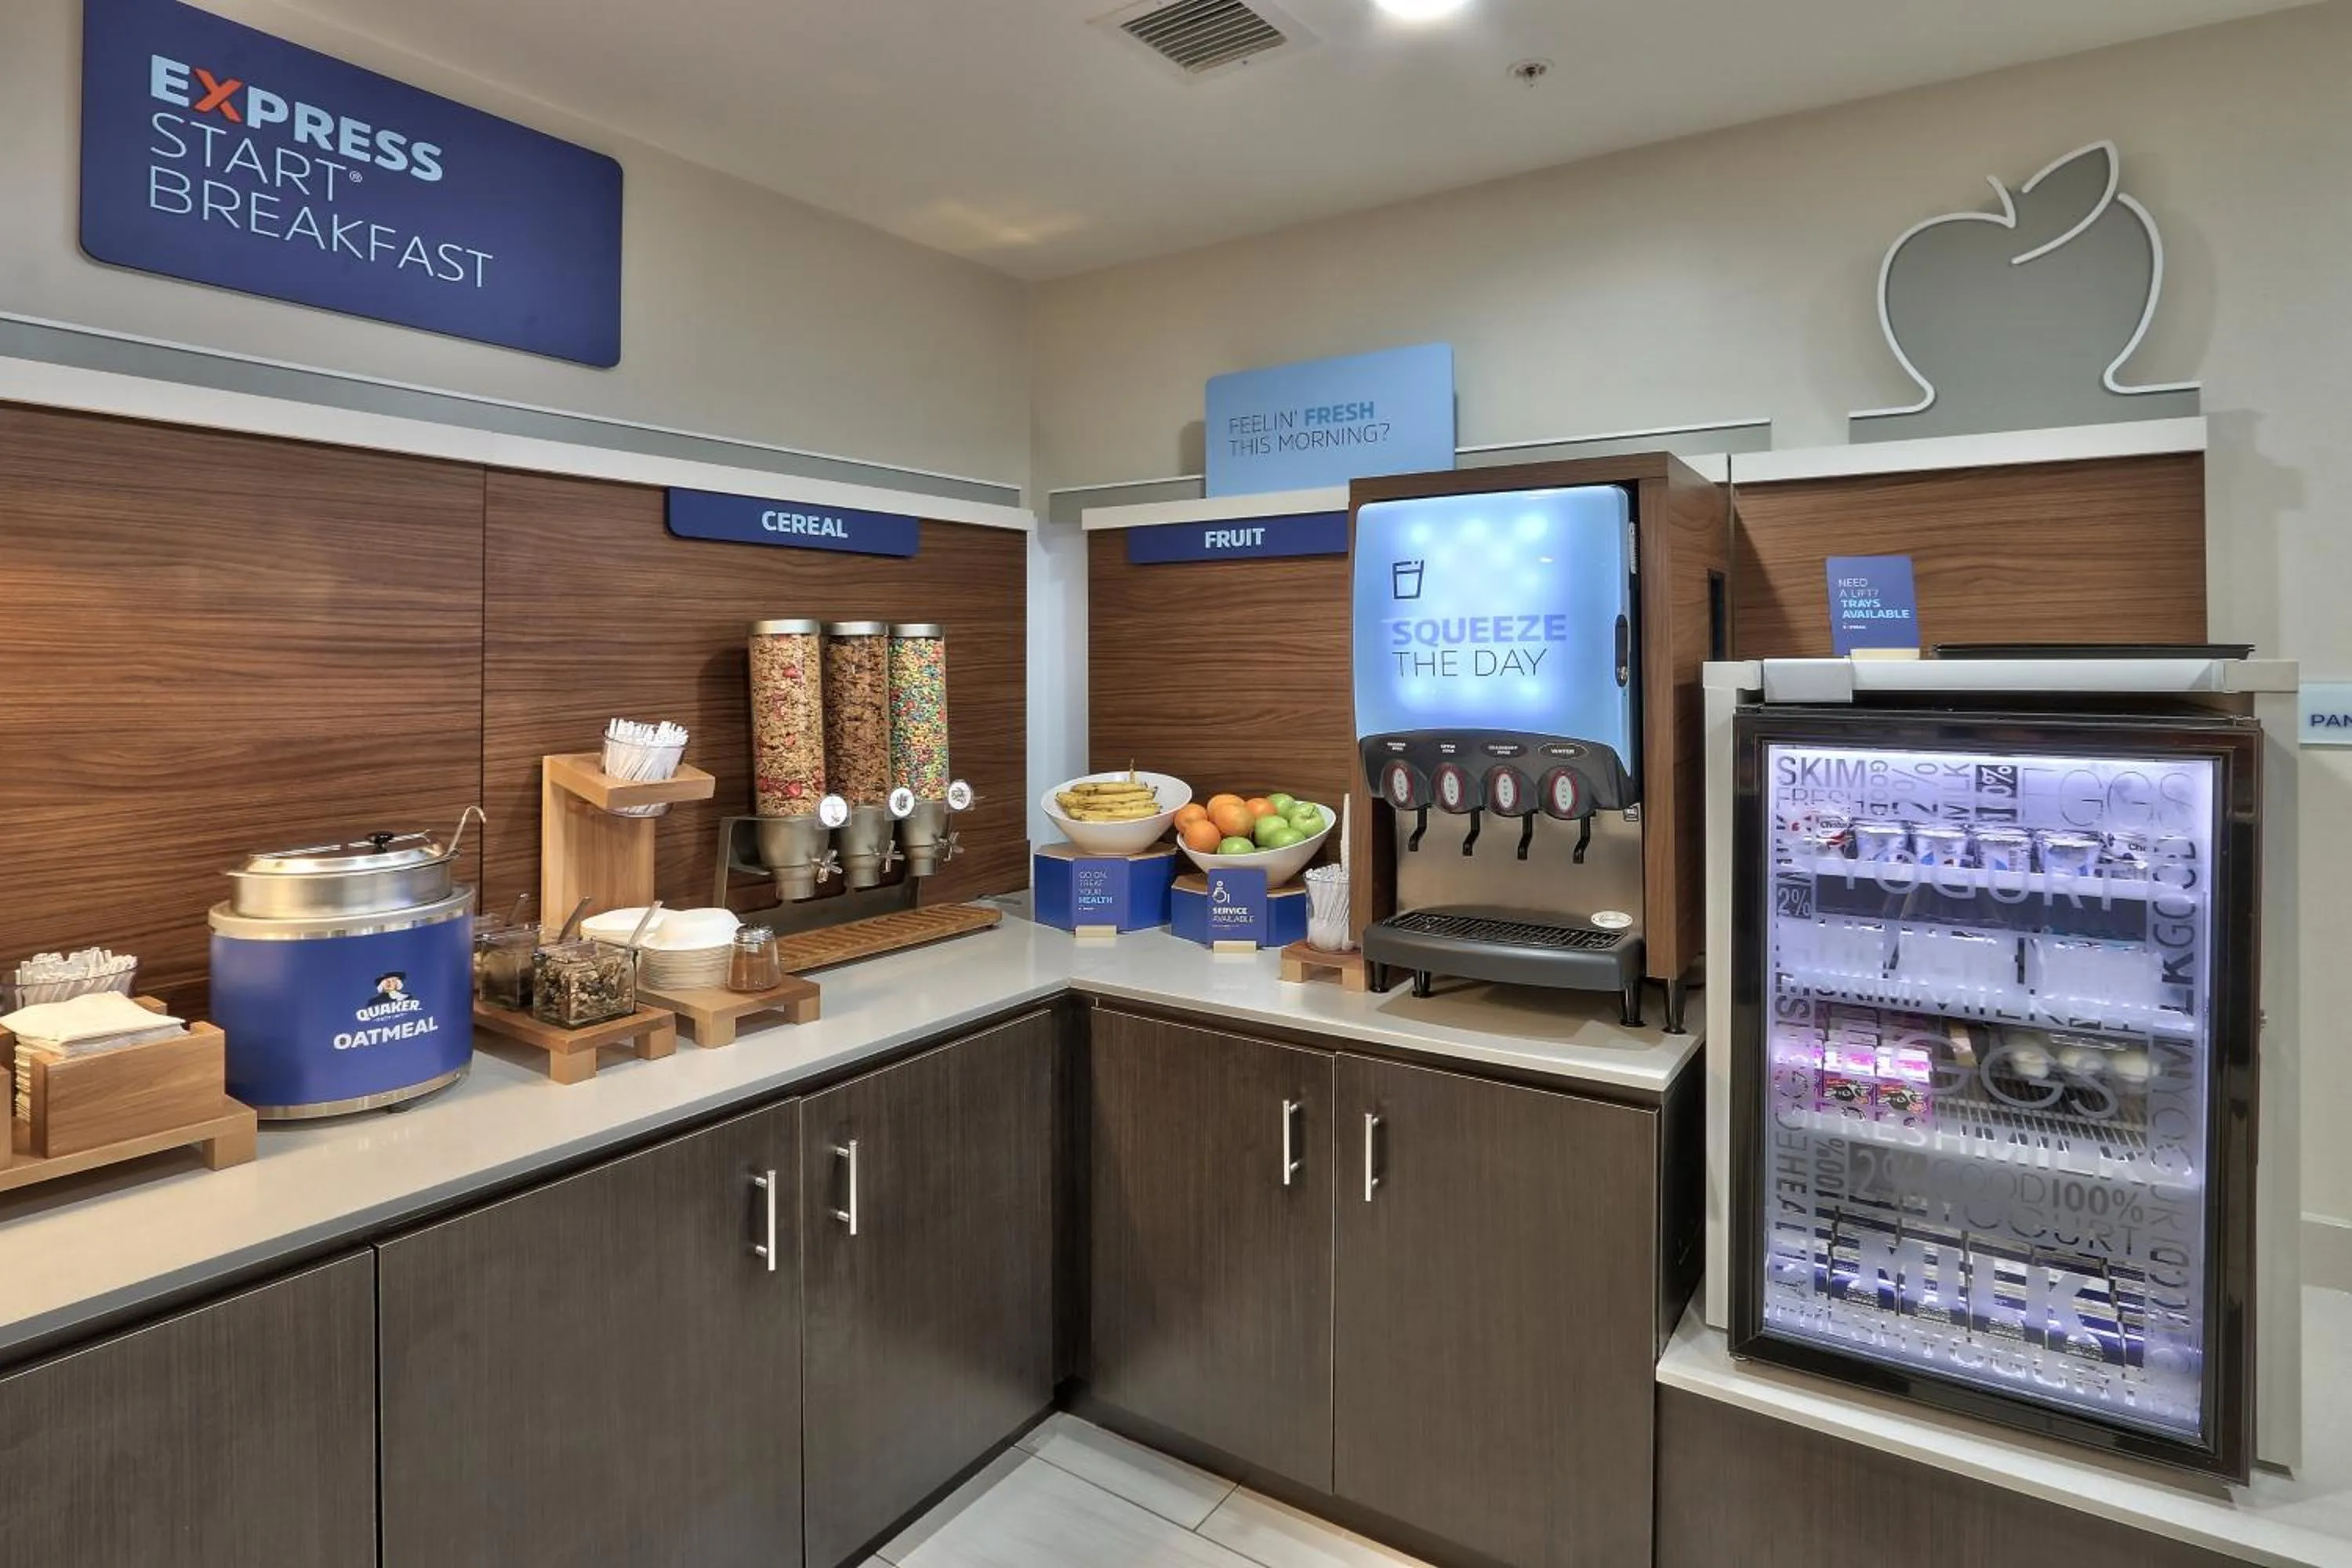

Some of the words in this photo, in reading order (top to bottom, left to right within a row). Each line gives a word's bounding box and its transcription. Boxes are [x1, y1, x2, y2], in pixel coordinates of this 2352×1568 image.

[151, 54, 444, 182] EXPRESS
[150, 165, 494, 289] BREAKFAST
[1229, 410, 1298, 435] FEELIN'
[1305, 401, 1374, 427] FRESH
[1229, 436, 1271, 456] THIS
[1279, 423, 1391, 452] MORNING?
[761, 510, 848, 539] CEREAL
[1205, 528, 1266, 548] FRUIT
[1838, 578, 1868, 587] NEED
[1838, 589, 1848, 598] A
[1840, 598, 1881, 608] TRAYS
[1842, 609, 1911, 619] AVAILABLE
[1392, 614, 1567, 647] SQUEEZE
[1392, 650, 1458, 677] THE
[1475, 648, 1548, 677] DAY
[1777, 756, 1865, 788] SKIM
[1870, 760, 1889, 816] GOOD
[1778, 887, 1811, 917] 2%
[356, 1000, 420, 1022] QUAKER
[333, 1016, 438, 1050] OATMEAL
[1816, 1138, 1844, 1200] 100%
[2053, 1178, 2144, 1223] 100%
[1860, 1233, 2091, 1331] MILK
